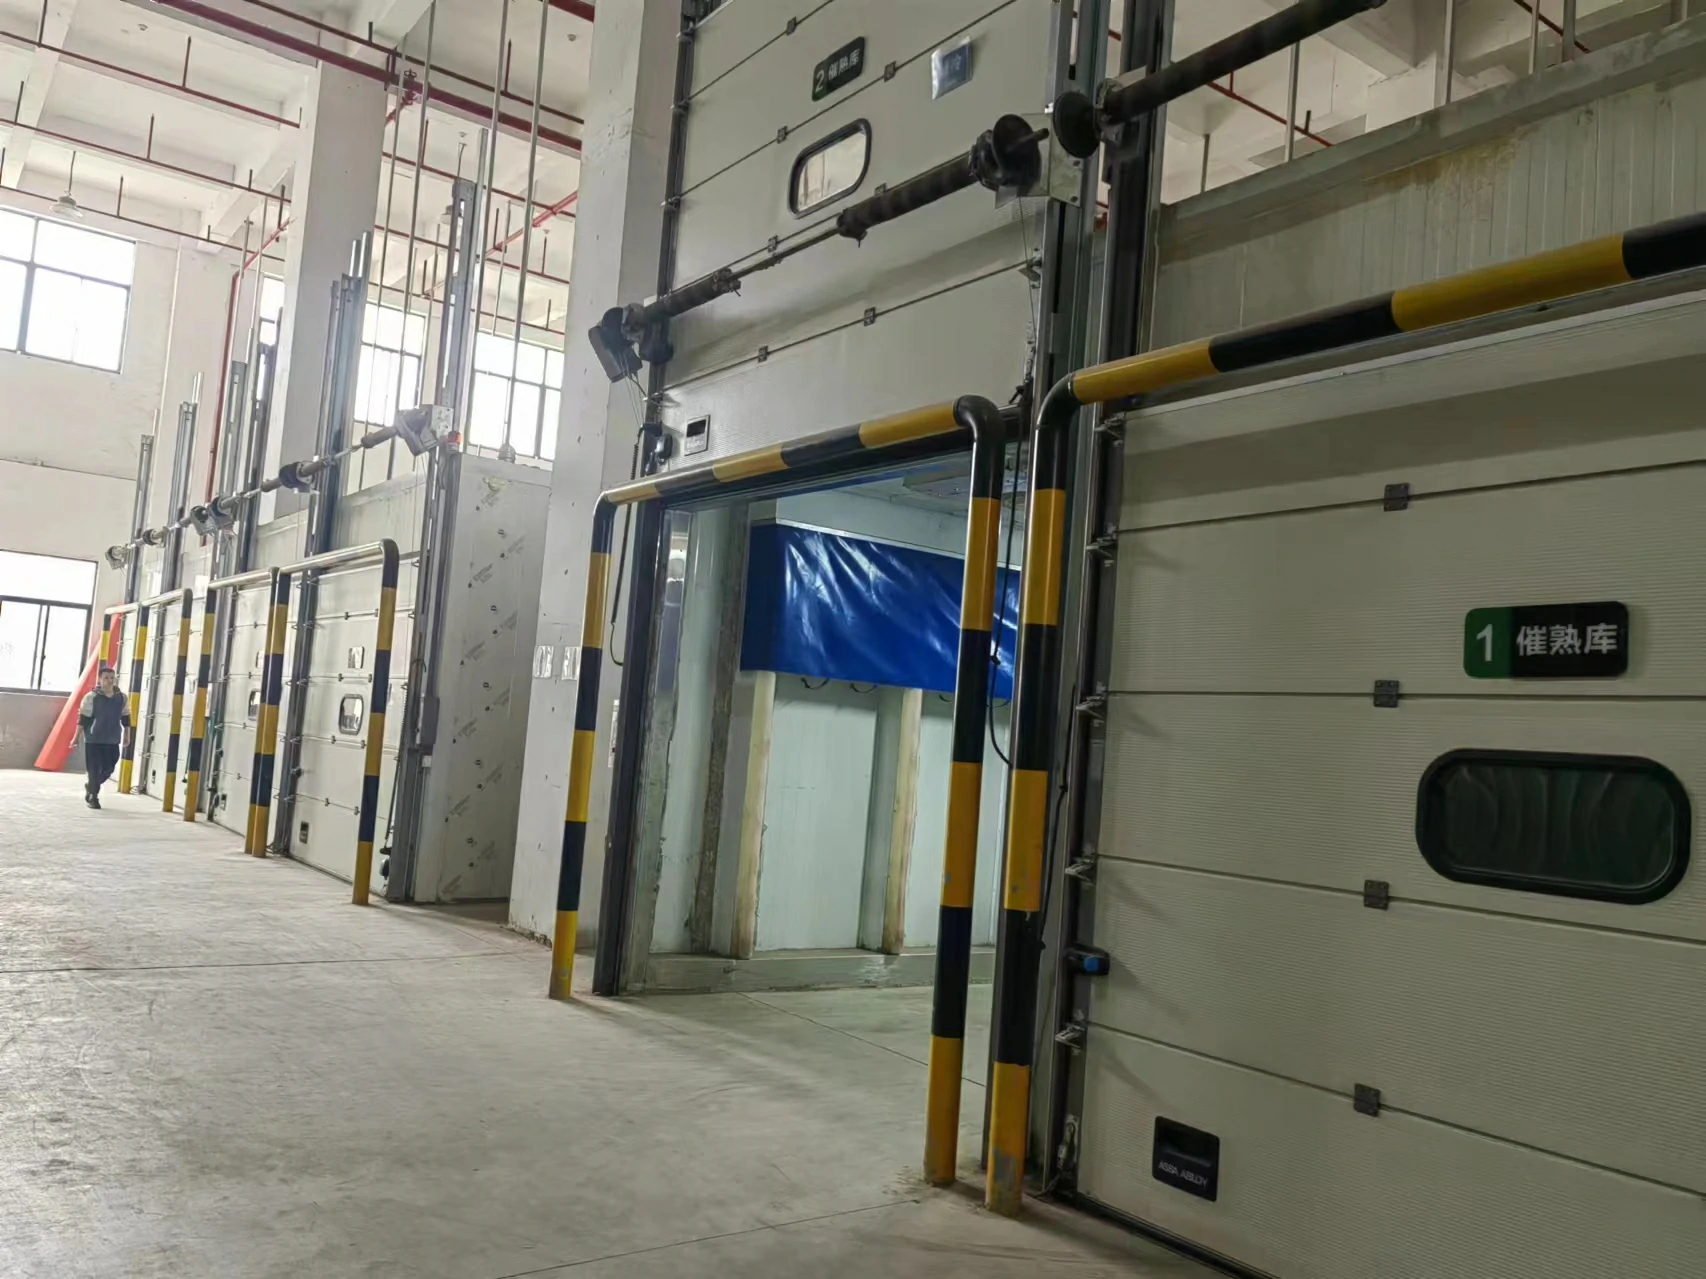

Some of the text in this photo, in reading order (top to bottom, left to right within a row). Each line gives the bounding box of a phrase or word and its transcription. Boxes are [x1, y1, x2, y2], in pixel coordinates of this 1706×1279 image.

[816, 69, 825, 92] 2
[1476, 622, 1618, 662] 1 催熟库
[1181, 1169, 1208, 1187] ABLOY
